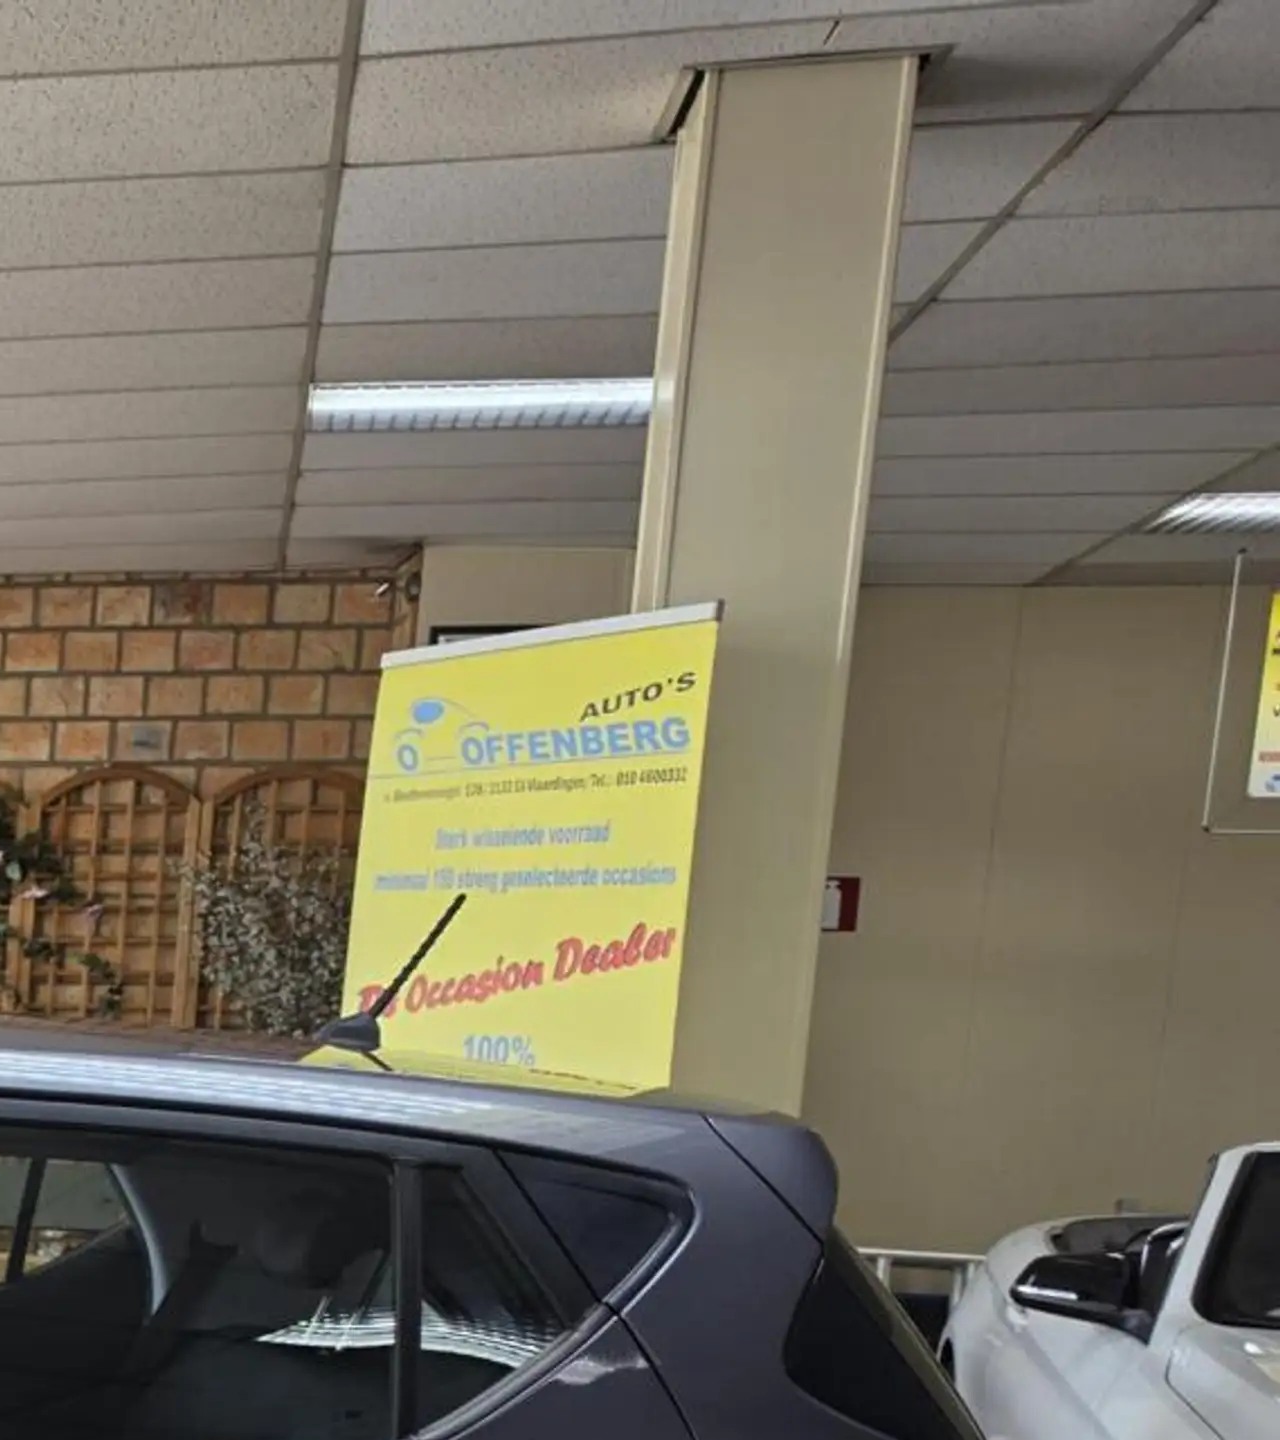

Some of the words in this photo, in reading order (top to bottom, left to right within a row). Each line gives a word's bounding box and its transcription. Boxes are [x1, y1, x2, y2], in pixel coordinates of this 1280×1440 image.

[578, 670, 697, 723] AUTO'S
[460, 715, 690, 766] OFFENBERG
[602, 859, 677, 886] occasions
[404, 955, 545, 1014] Occasion
[552, 921, 677, 982] Dealer
[463, 1034, 536, 1066] 100%
